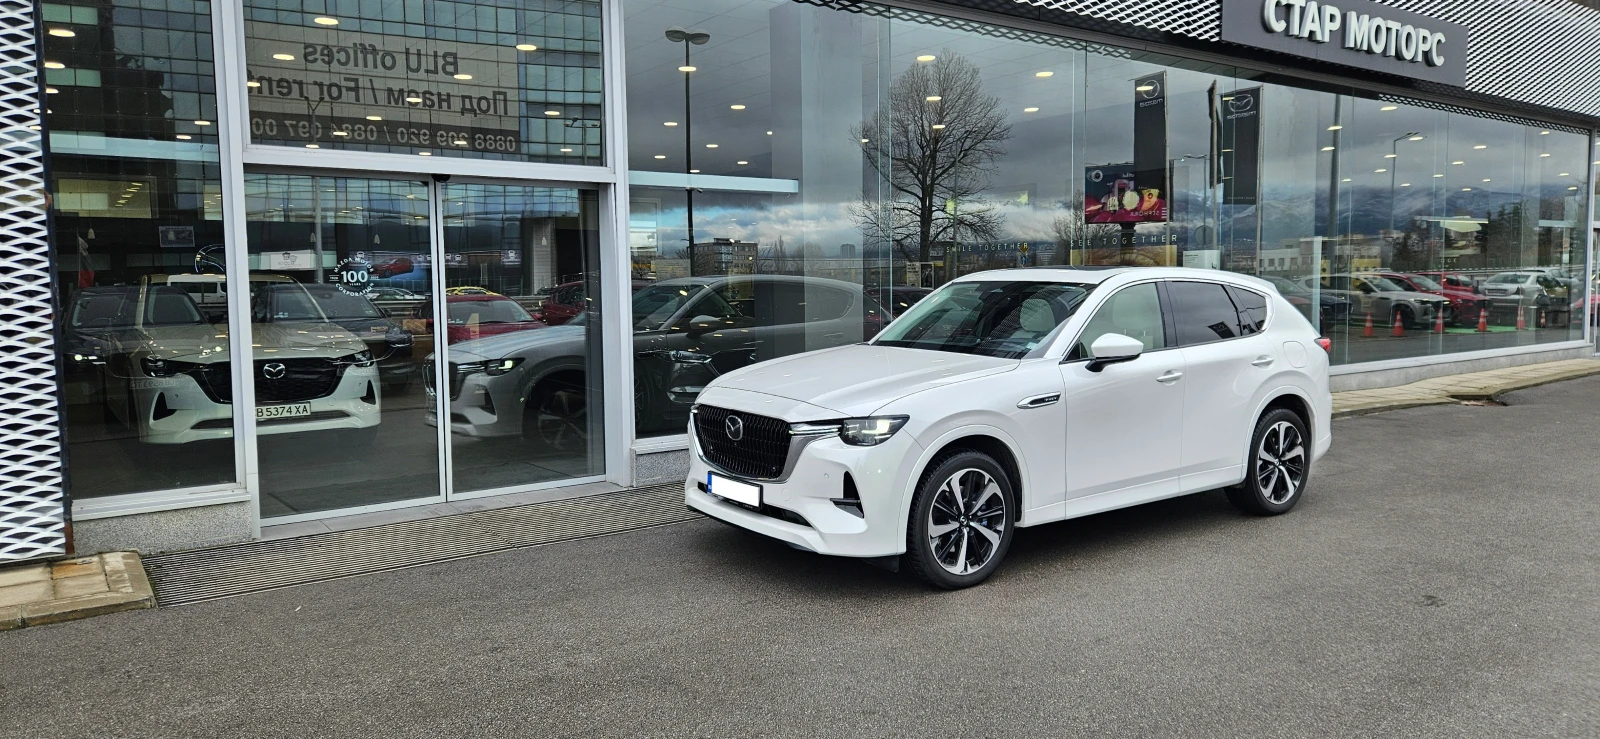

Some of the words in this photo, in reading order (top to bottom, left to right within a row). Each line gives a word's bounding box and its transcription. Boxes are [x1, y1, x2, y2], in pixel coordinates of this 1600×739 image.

[1262, 0, 1342, 43] СТАР
[1344, 11, 1447, 67] МОТОРС
[946, 244, 972, 253] SMILE
[978, 241, 1028, 251] TOGETHER
[1070, 239, 1092, 247] SEE
[1103, 233, 1177, 245] TOGETHER
[333, 257, 353, 273] MAZDA
[340, 270, 369, 283] 100
[335, 283, 375, 297] CORPORATION
[265, 405, 293, 417] 5374
[294, 404, 309, 415] XA
